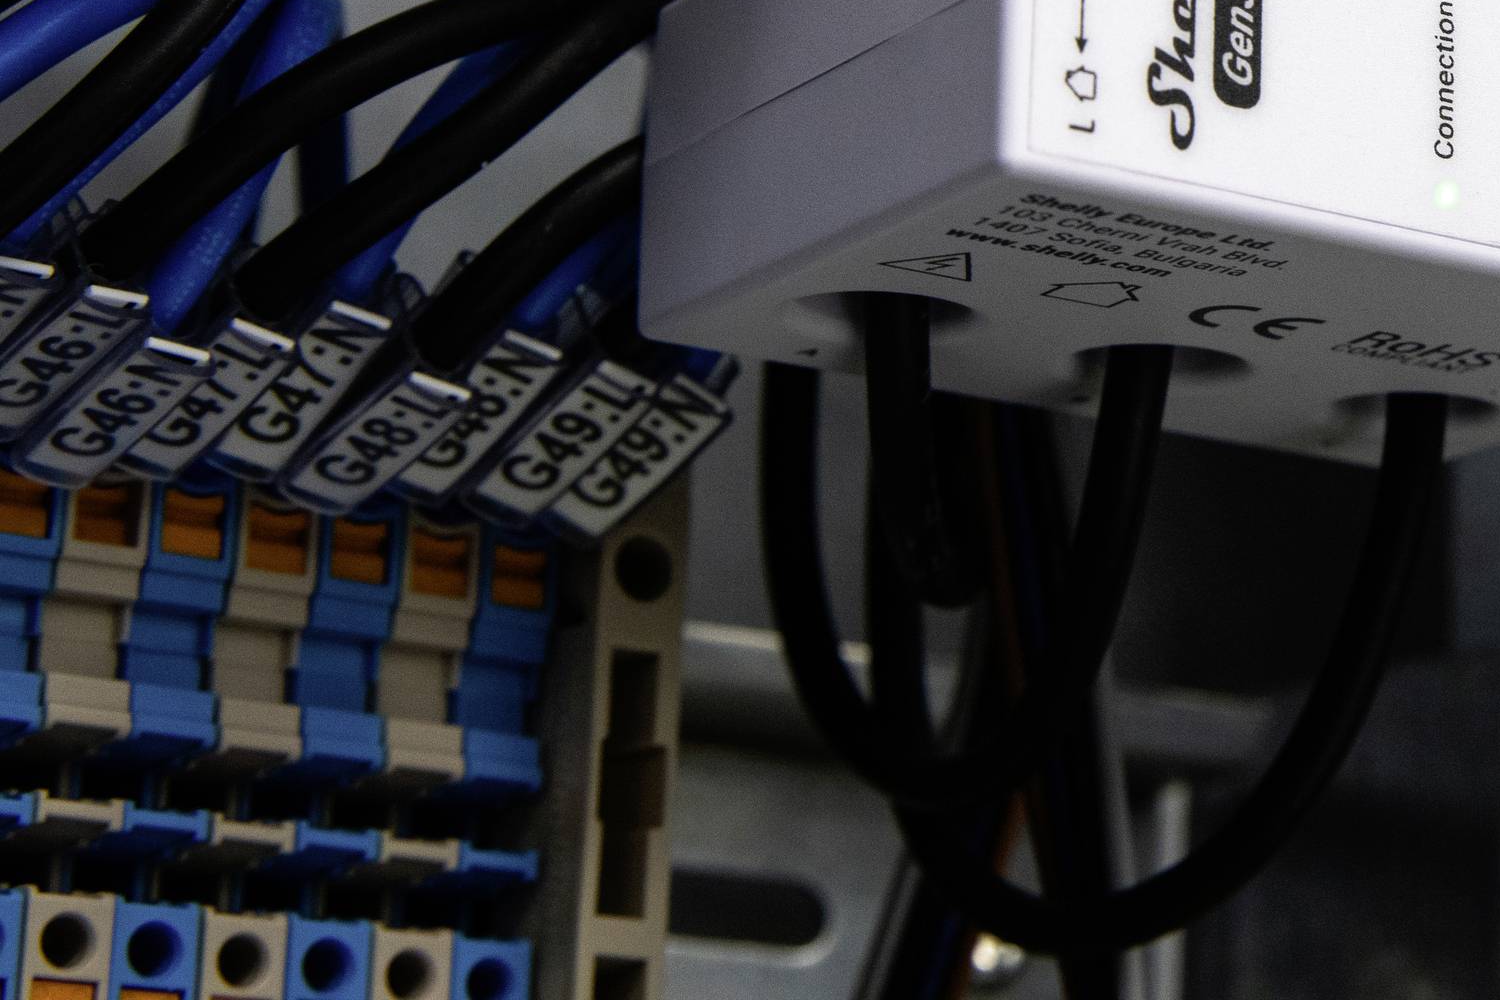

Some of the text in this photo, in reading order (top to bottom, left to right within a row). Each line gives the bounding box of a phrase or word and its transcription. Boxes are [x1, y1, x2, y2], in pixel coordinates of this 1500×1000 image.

[1433, 0, 1455, 160] Connection
[1069, 120, 1096, 133] L
[974, 216, 1248, 278] 1407 Sofia, Bulgaria
[1001, 206, 1288, 271] 103 Cherni Vrah Blvd.
[1019, 193, 1275, 251] Shelly Europe Ltd.
[946, 229, 1173, 278] www.shelly.com
[1188, 304, 1327, 340] CE
